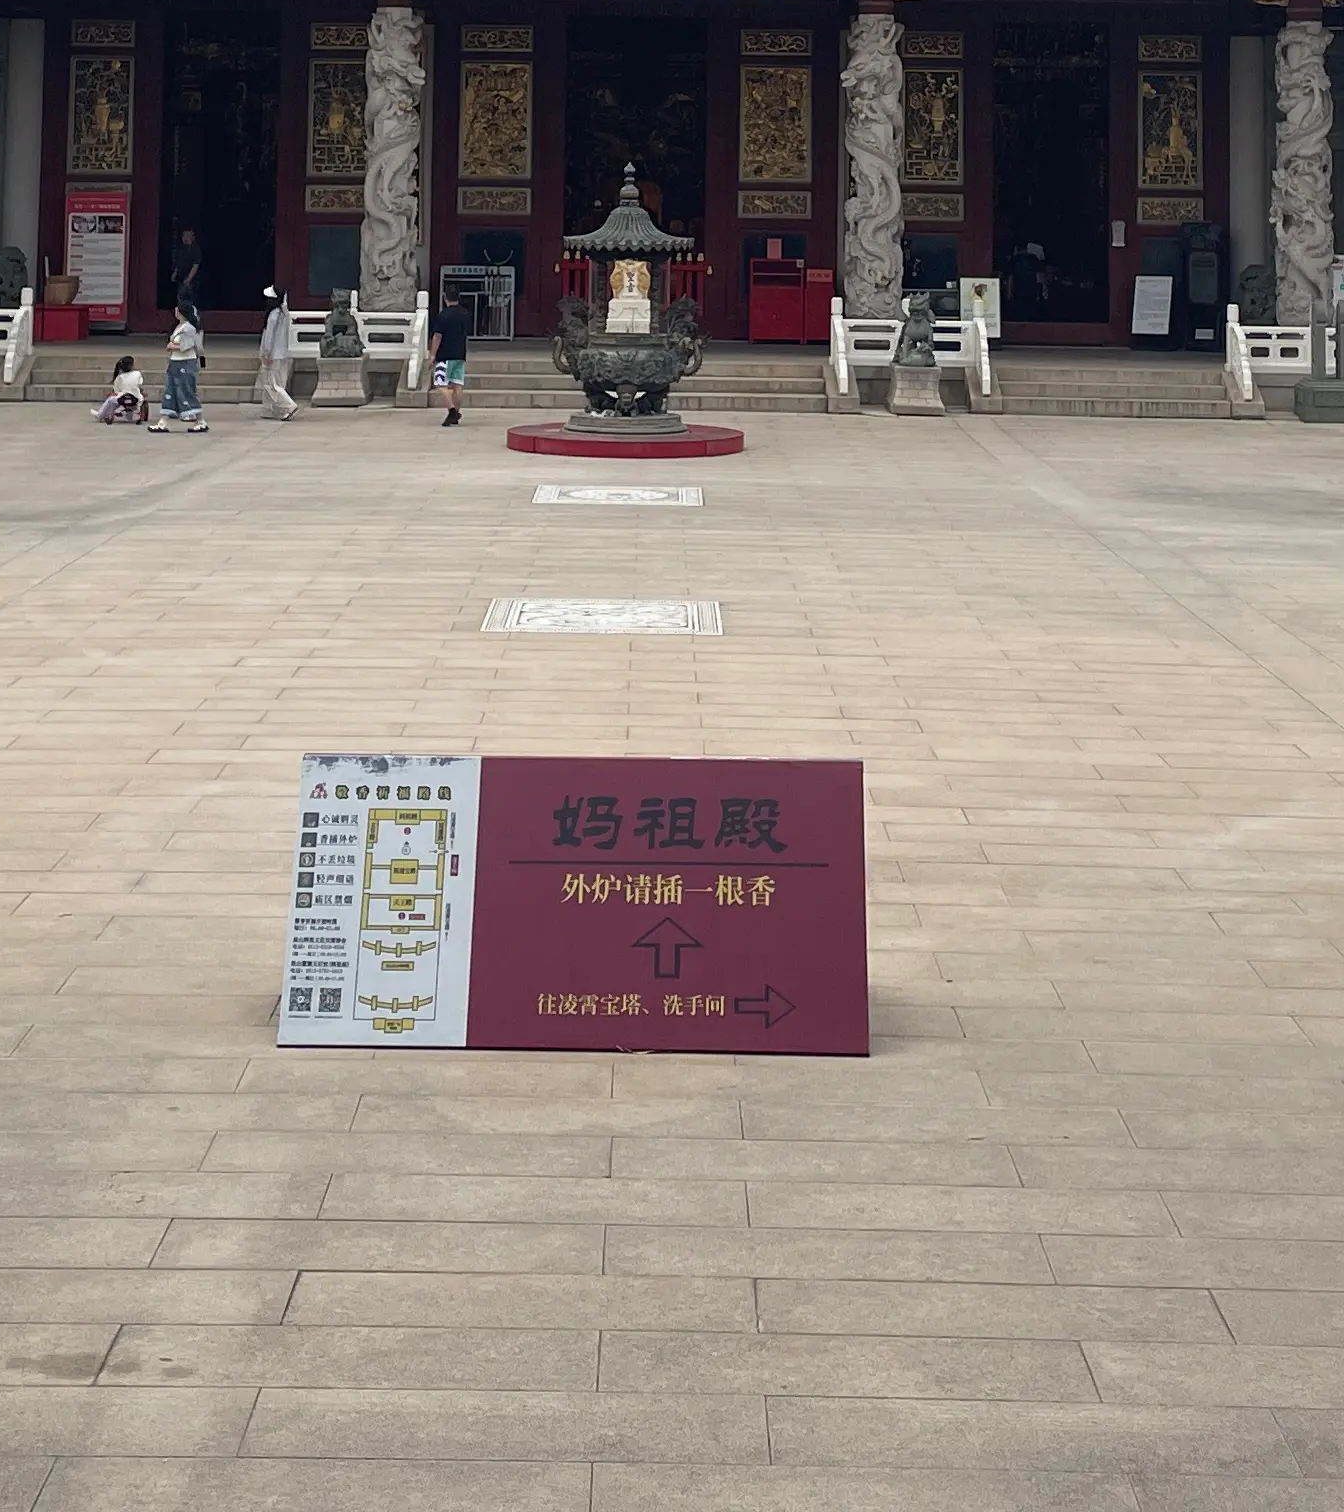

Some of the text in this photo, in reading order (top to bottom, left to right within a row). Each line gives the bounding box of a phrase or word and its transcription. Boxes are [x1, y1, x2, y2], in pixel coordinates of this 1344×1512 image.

[551, 794, 789, 853] 妈祖殿
[559, 873, 777, 906] 外炉请插一根香
